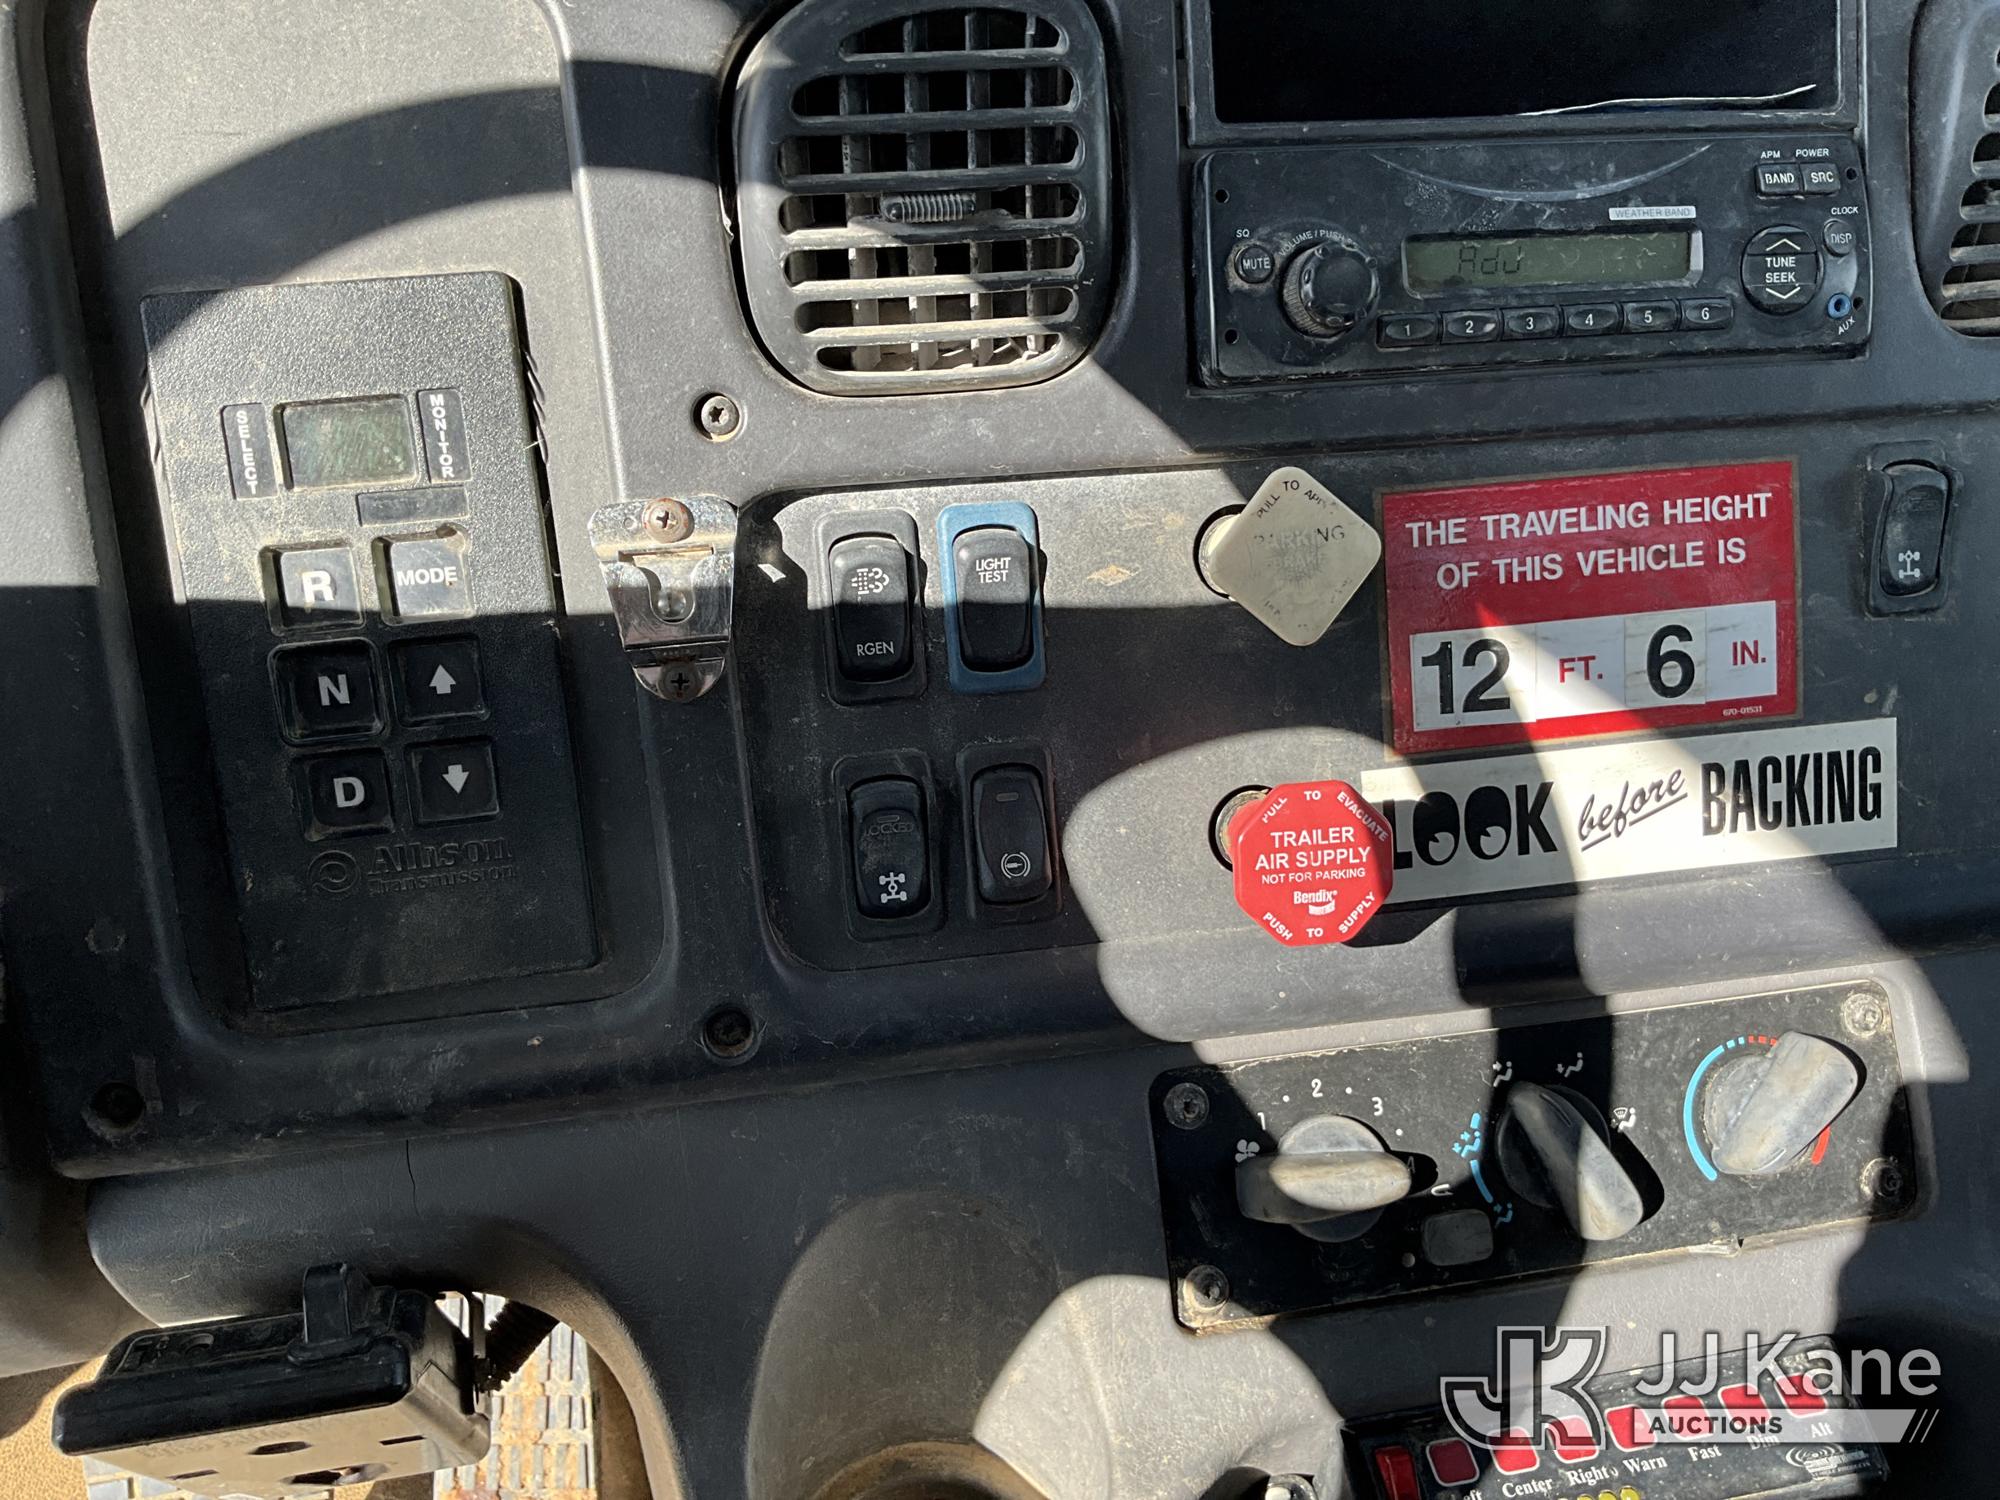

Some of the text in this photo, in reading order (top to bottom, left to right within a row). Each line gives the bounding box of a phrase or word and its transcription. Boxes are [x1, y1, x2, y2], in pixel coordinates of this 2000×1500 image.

[1760, 148, 1830, 159] APM POWER
[1765, 171, 1835, 184] BAND SRC
[1615, 207, 1691, 219] WEATHER BAND
[1831, 206, 1859, 215] CLOCK
[1236, 229, 1250, 238] SQ
[1830, 232, 1852, 244] DISP
[1279, 230, 1313, 256] VOLUME
[1242, 256, 1271, 270] MUTE
[1765, 257, 1796, 268] TUNE
[1765, 271, 1797, 283] SEEK
[1585, 313, 1594, 326] 4
[1644, 310, 1652, 323] 5
[1701, 307, 1710, 320] 6
[1404, 324, 1411, 336] 1
[1465, 320, 1474, 334] 2
[1526, 316, 1534, 330] 3
[1837, 316, 1856, 335] AUX
[429, 394, 455, 479] MONITOR
[236, 410, 258, 495] SELECT
[1282, 479, 1300, 492] TO
[1405, 492, 1773, 548] THE TRAVELING HEIGHT
[975, 557, 1012, 572] LIGHT
[1436, 537, 1746, 591] OF THIS VEHICLE IS
[396, 566, 458, 587] MODE
[978, 570, 1009, 584] TEST
[302, 570, 335, 604] R
[856, 641, 895, 657] RGEN
[1421, 624, 1767, 715] 12 FT. 6 IN.
[318, 675, 350, 707] N
[333, 776, 366, 808] D
[1262, 790, 1389, 842] PULL TO EVACUATE
[1389, 745, 1883, 870] LOOK before BACKING
[1270, 826, 1355, 848] TRAILER
[1254, 846, 1371, 871] AIR SUPPLY
[1262, 867, 1366, 885] NOT FOR PARKING
[1293, 889, 1334, 904] Bendix
[1262, 912, 1293, 941] PUSH
[1306, 927, 1323, 938] TO
[1338, 891, 1375, 934] SUPPLY
[1311, 1078, 1323, 1098] 2
[1371, 1097, 1384, 1116] 3
[1257, 1112, 1266, 1130] 1
[1810, 1421, 1834, 1440] Alt
[1746, 1433, 1780, 1451] Dim
[1687, 1442, 1723, 1462] Fast
[1622, 1454, 1668, 1474] Warn
[1567, 1465, 1608, 1487] Right
[1502, 1477, 1553, 1498] Center
